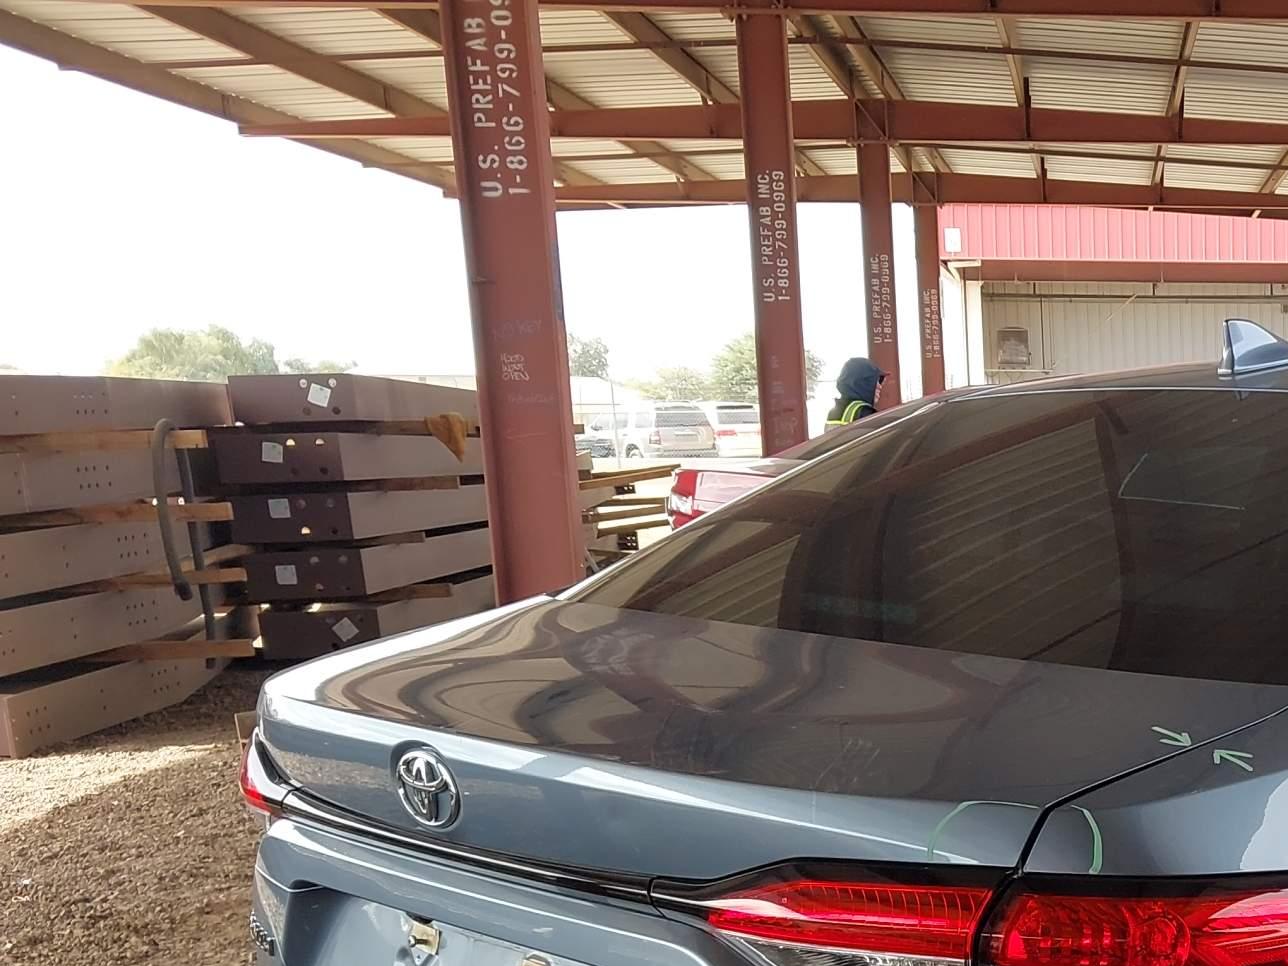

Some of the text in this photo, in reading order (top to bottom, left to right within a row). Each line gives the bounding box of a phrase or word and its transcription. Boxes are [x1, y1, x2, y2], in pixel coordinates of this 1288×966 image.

[464, 17, 504, 198] U.S. PREFAB
[757, 169, 776, 302] U.S. PREFAB INC.
[771, 170, 791, 301] 1-866-799-0969
[871, 278, 882, 319] PREFAB
